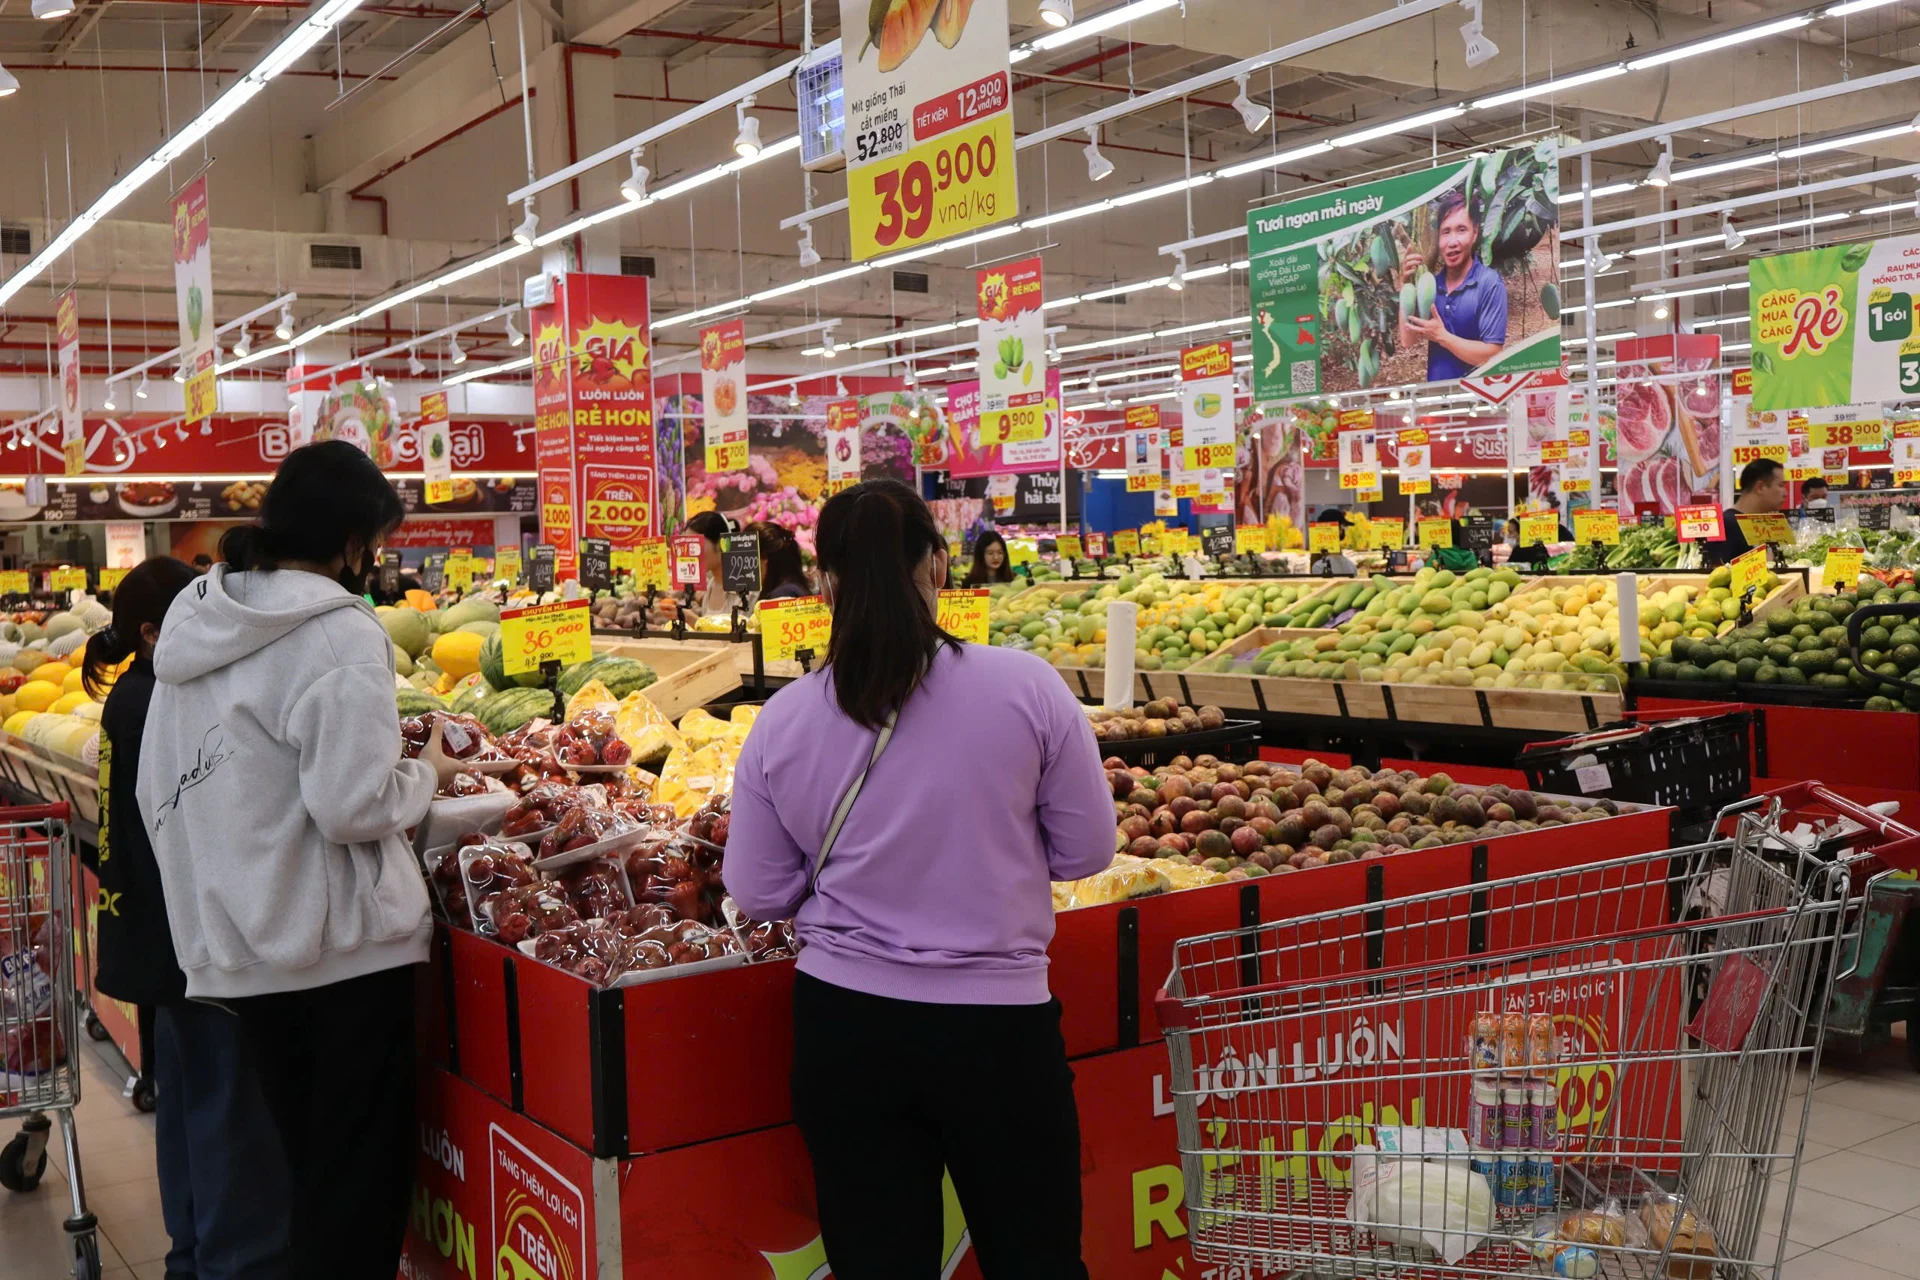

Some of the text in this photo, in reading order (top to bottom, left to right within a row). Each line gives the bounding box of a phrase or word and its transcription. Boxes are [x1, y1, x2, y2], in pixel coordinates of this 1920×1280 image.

[852, 81, 906, 115] Mít giống Thái
[861, 108, 898, 131] cắt miếng
[916, 112, 931, 129] TIẾT
[932, 108, 949, 125] KIỆM
[938, 190, 996, 224] vnd/kg
[1256, 193, 1384, 234] Tươi ngon mỗi ngày
[1887, 264, 1904, 273] RAU
[1761, 289, 1843, 355] CÀNG Rẻ
[1762, 310, 1788, 323] MUA
[1884, 308, 1907, 323] GÓI
[1760, 325, 1793, 339] CÀNG
[585, 335, 636, 366] GIÁ
[579, 389, 644, 401] LUÔN LUÔN
[575, 403, 650, 426] RẺ HƠN
[1029, 472, 1059, 489] Thủy
[604, 489, 633, 501] TRÊN
[1024, 488, 1041, 504] hải
[589, 505, 646, 522] 2.000
[522, 606, 553, 616] KHUYẾN
[1293, 1016, 1405, 1082] LUÔN
[520, 1169, 544, 1200] THÊM
